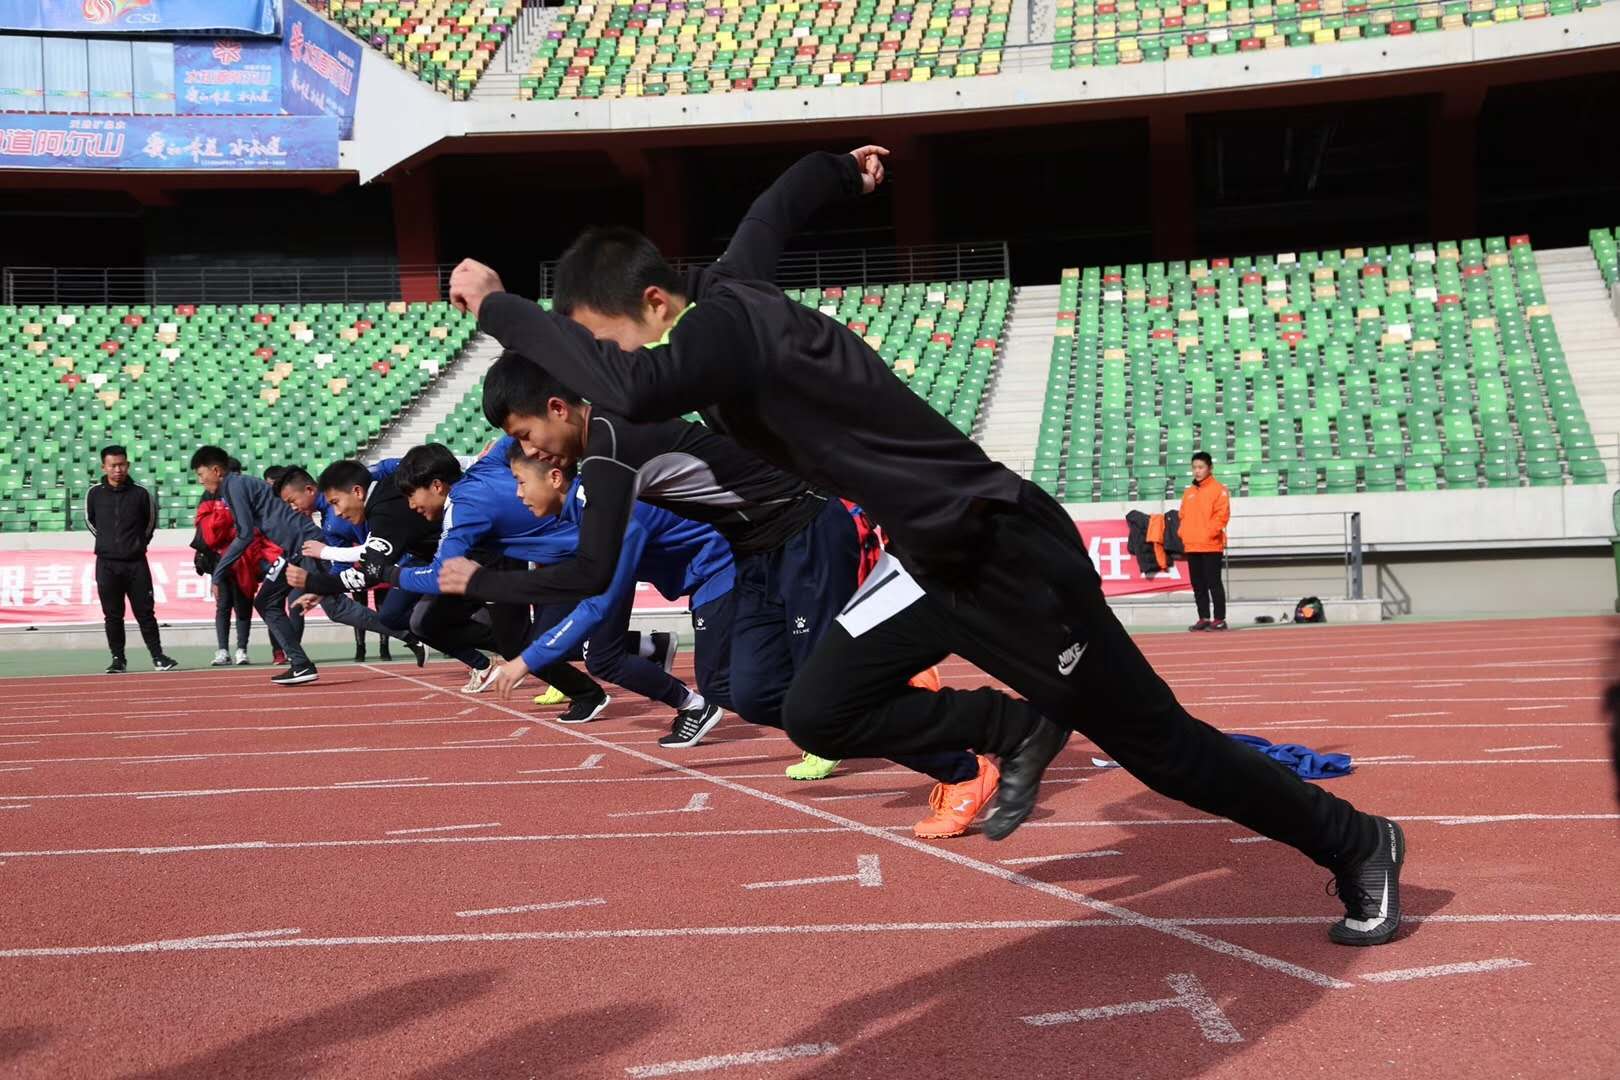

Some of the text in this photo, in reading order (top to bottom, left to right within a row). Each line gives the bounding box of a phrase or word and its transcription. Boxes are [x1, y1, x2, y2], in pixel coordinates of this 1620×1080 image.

[0, 128, 126, 158] 道阿尔山
[1058, 642, 1081, 667] NIKE
